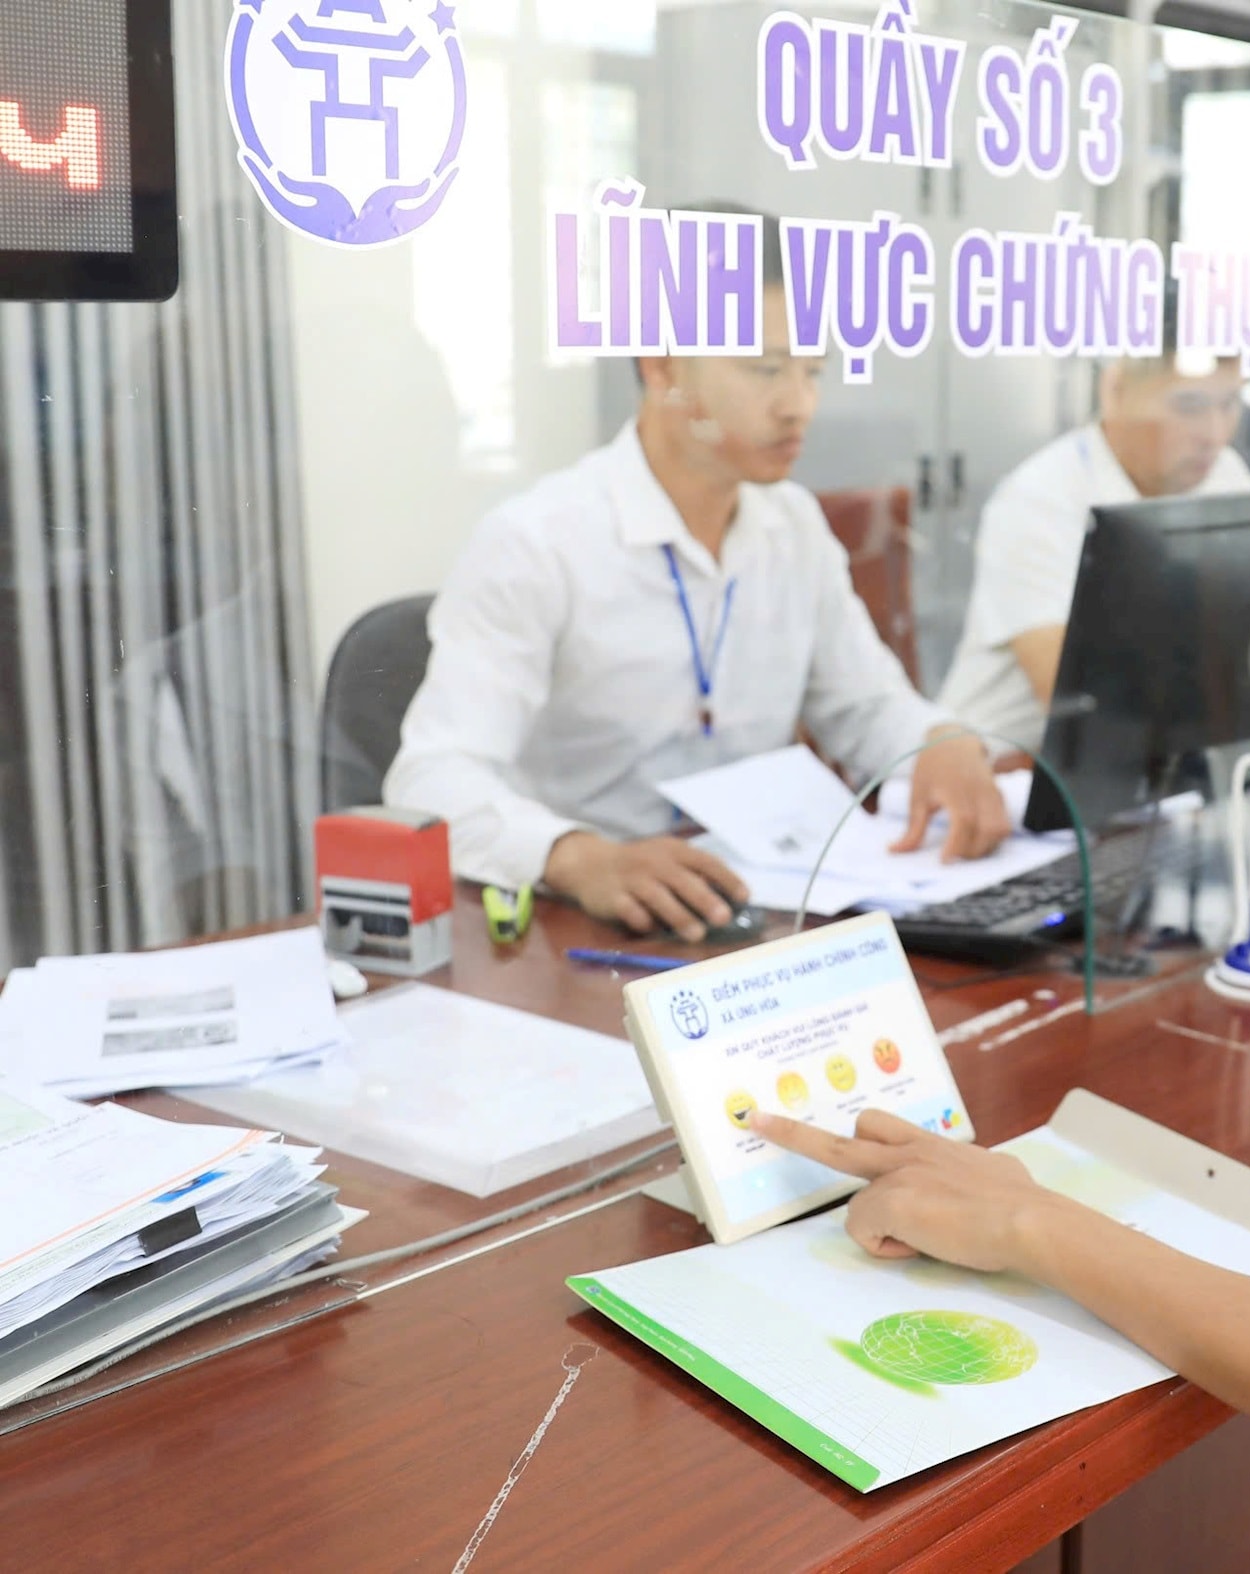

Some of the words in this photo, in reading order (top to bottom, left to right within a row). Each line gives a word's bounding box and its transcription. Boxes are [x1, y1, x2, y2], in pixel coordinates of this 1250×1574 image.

[761, 0, 961, 165] QUẦY
[981, 16, 1073, 175] SỐ
[1080, 68, 1121, 181] 3
[552, 182, 759, 351] LĨNH
[784, 216, 931, 378] VỰC
[956, 216, 1160, 352] CHỨNG
